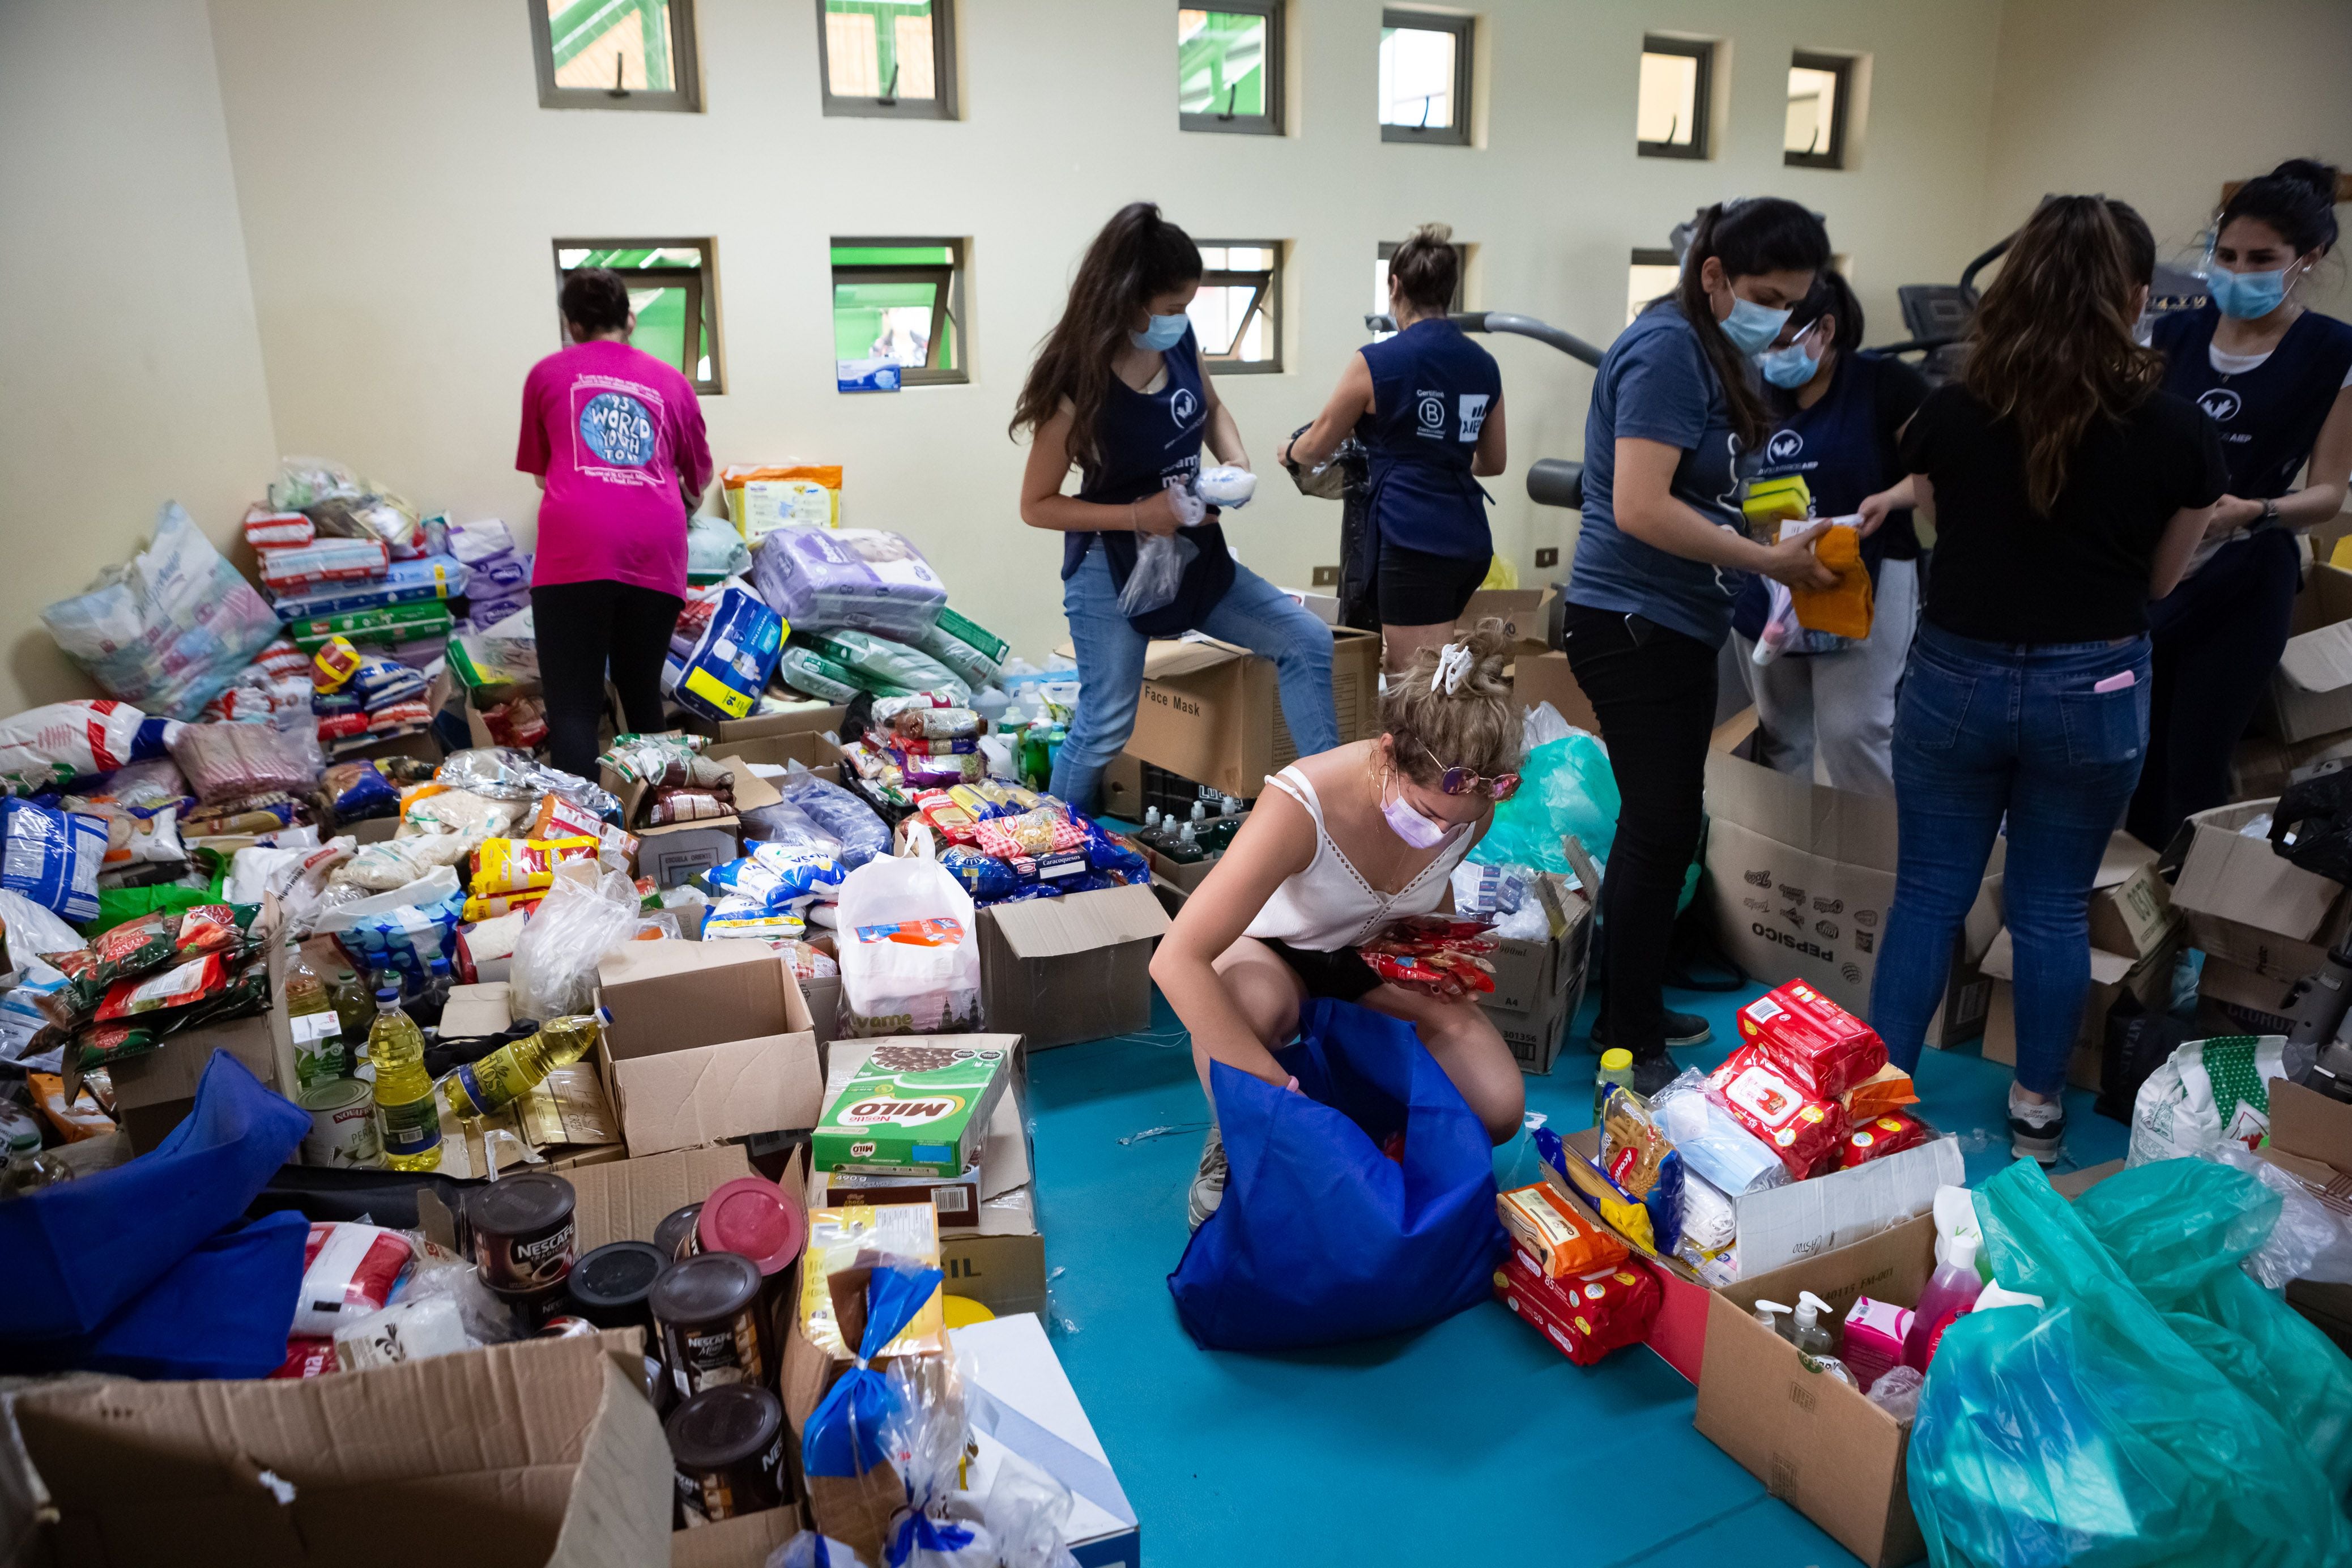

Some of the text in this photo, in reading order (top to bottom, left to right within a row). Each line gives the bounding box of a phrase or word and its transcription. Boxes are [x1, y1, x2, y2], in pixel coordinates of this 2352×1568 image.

[1417, 389, 1445, 398] Certified
[591, 407, 651, 439] WORLD
[1145, 685, 1200, 717] Face Mask
[665, 853, 713, 864] ESCUELA ORIENTE
[1043, 855, 1080, 866] Caracoquesos
[1752, 922, 1834, 963] PEPSICO
[1505, 998, 1518, 1007] A4
[856, 1013, 913, 1029] vame
[1503, 1030, 1537, 1042] 301356
[1779, 1054, 1789, 1066] 85
[851, 1103, 949, 1117] MILO
[1747, 1117, 1758, 1128] 85
[1518, 1250, 1541, 1277] Simond's
[1545, 1275, 1556, 1290] 85
[1860, 1267, 1894, 1290] FM-001
[1533, 1311, 1544, 1325] 85
